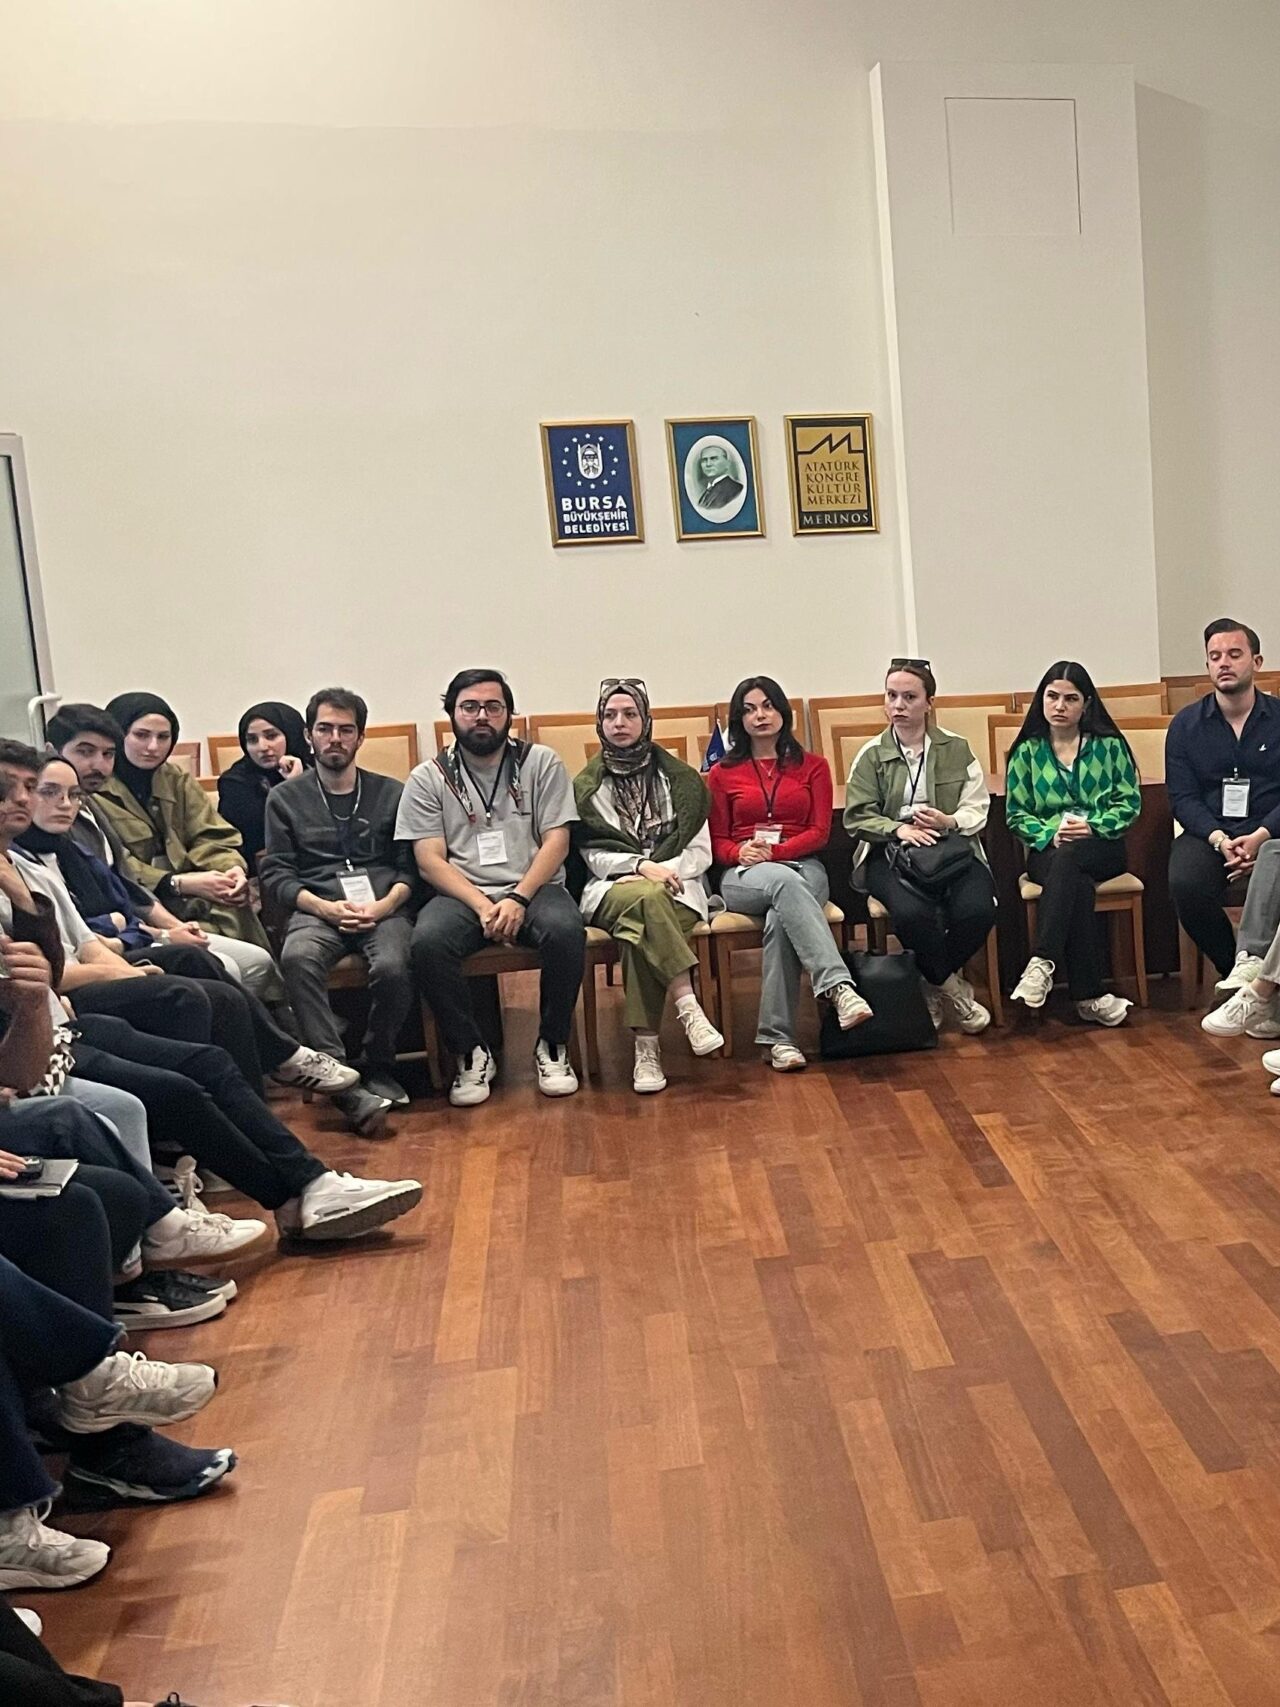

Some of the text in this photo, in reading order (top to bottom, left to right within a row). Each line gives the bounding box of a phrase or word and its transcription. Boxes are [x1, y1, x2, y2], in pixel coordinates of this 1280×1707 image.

[806, 472, 860, 483] KONGRE
[561, 495, 627, 511] BURSA
[807, 493, 861, 505] MERKEZİ
[563, 508, 628, 523] BÜYÜKŞEHİR
[564, 520, 629, 534] BELEDİYESİ
